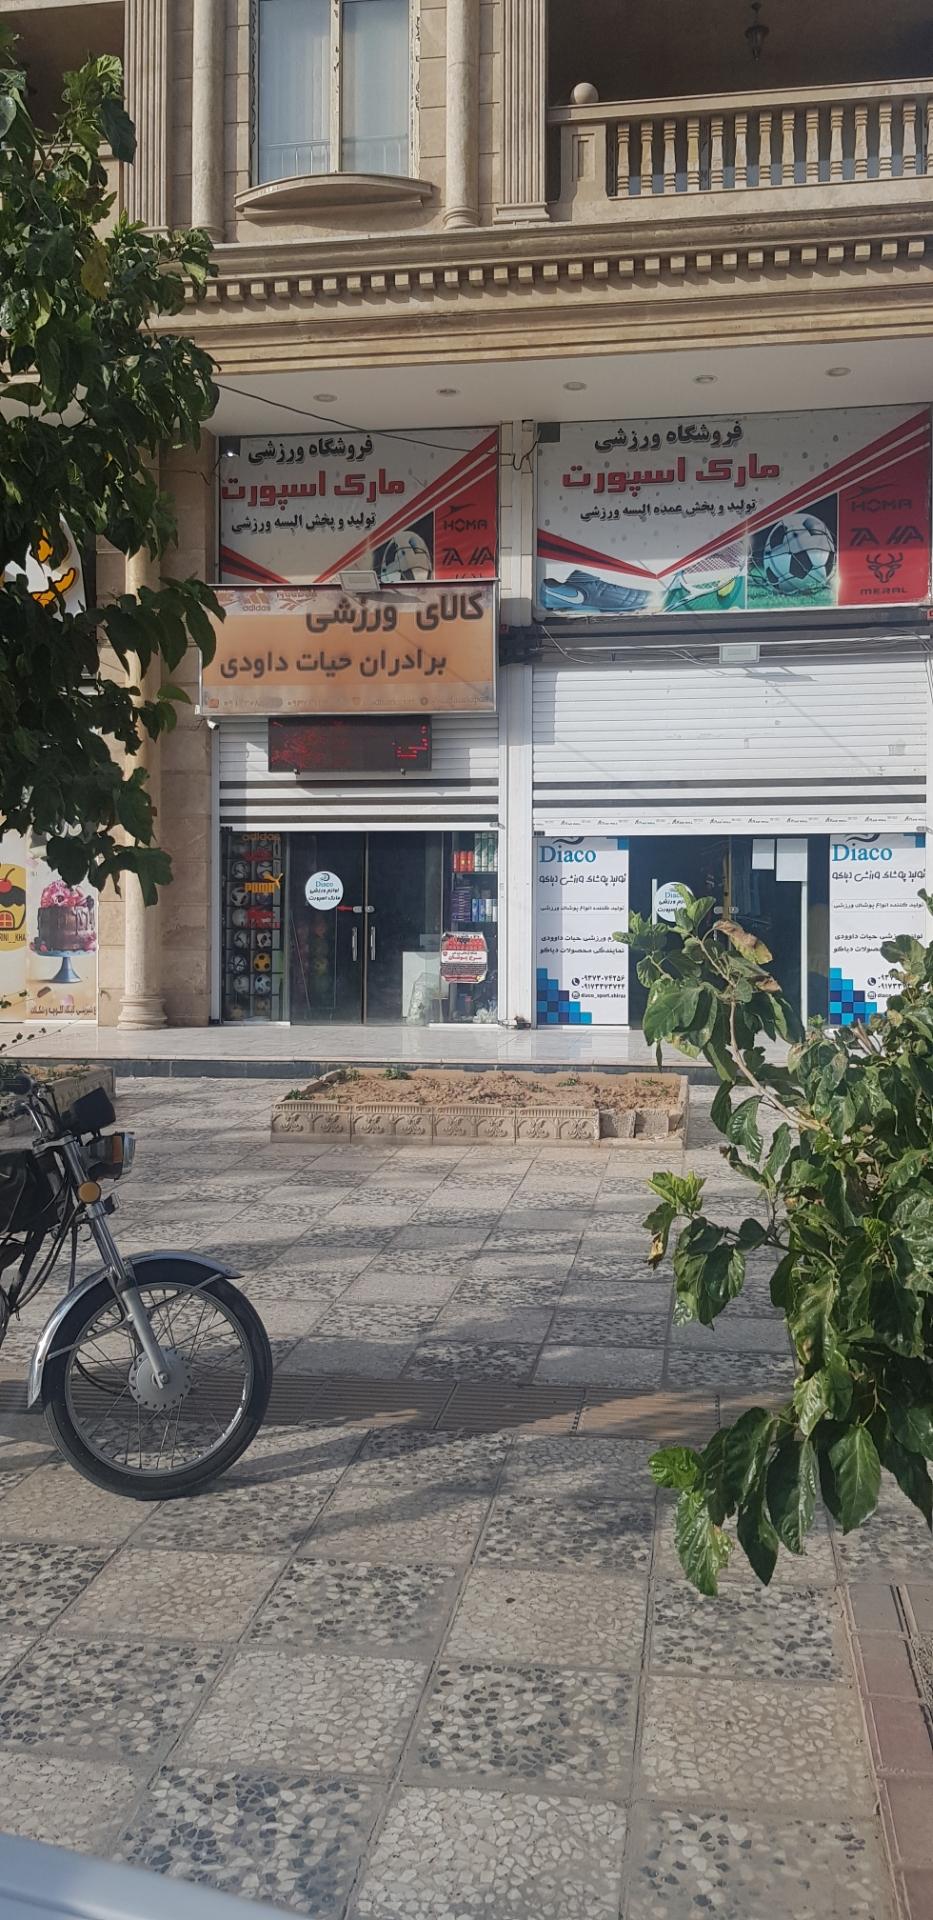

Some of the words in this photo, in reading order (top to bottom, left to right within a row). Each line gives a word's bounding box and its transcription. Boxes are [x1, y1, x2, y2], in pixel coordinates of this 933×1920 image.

[594, 428, 661, 452] ورزشی
[666, 421, 743, 446] فروشگاه
[248, 440, 304, 464] ورزشی
[308, 435, 374, 461] فروشگاه
[562, 456, 686, 497] اسپورت
[695, 453, 780, 488] مارک
[221, 470, 326, 511] اسپورت
[334, 468, 405, 503] مارک
[622, 503, 651, 519] البسه
[653, 504, 682, 514] عمده
[685, 501, 715, 517] پخش
[717, 505, 724, 515] و
[727, 498, 757, 514] تولید
[851, 498, 912, 512] HOMA
[347, 512, 376, 529] تولید
[580, 506, 620, 521] ورزشی
[231, 517, 271, 534] ورزشی
[274, 514, 303, 533] البسه
[305, 513, 335, 531] پخش
[338, 520, 344, 530] و
[444, 518, 488, 532] HOMA
[242, 604, 271, 612] adidas
[306, 596, 397, 633] ورزشی
[416, 591, 484, 631] کالای
[220, 651, 289, 679] داودی
[296, 651, 352, 678] حیات
[360, 648, 447, 677] برادران
[539, 845, 596, 863] Diaco
[832, 843, 893, 862] Diaco
[560, 874, 584, 885] ورزشی
[586, 875, 608, 886] پوشاک
[610, 873, 627, 887] تولید
[854, 870, 881, 882] ورزشی
[882, 871, 906, 882] پوشاک
[908, 868, 926, 883] تولید
[583, 934, 606, 942] ورزشی
[560, 946, 592, 954] محصولات
[593, 946, 624, 955] نمایندگی
